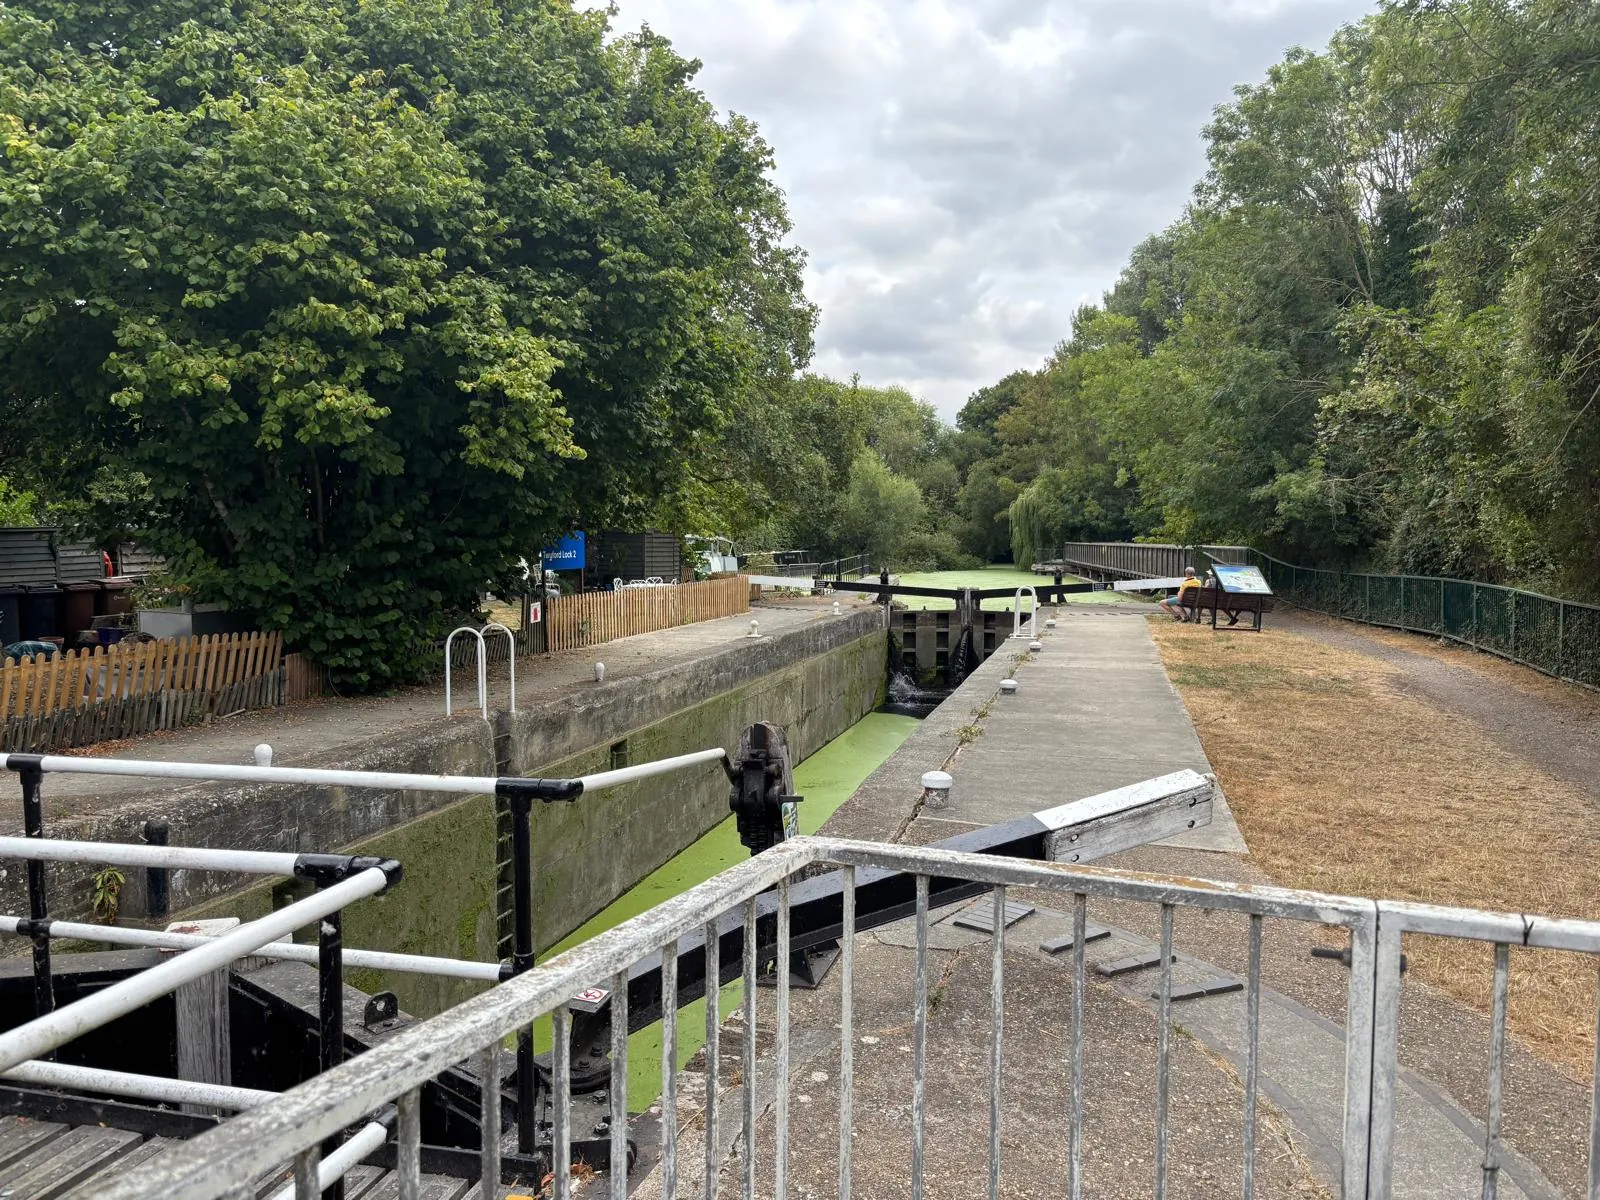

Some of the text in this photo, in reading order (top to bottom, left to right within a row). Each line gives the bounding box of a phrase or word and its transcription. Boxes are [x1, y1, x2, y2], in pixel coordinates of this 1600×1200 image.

[543, 550, 577, 562] Twyford Lock 2
